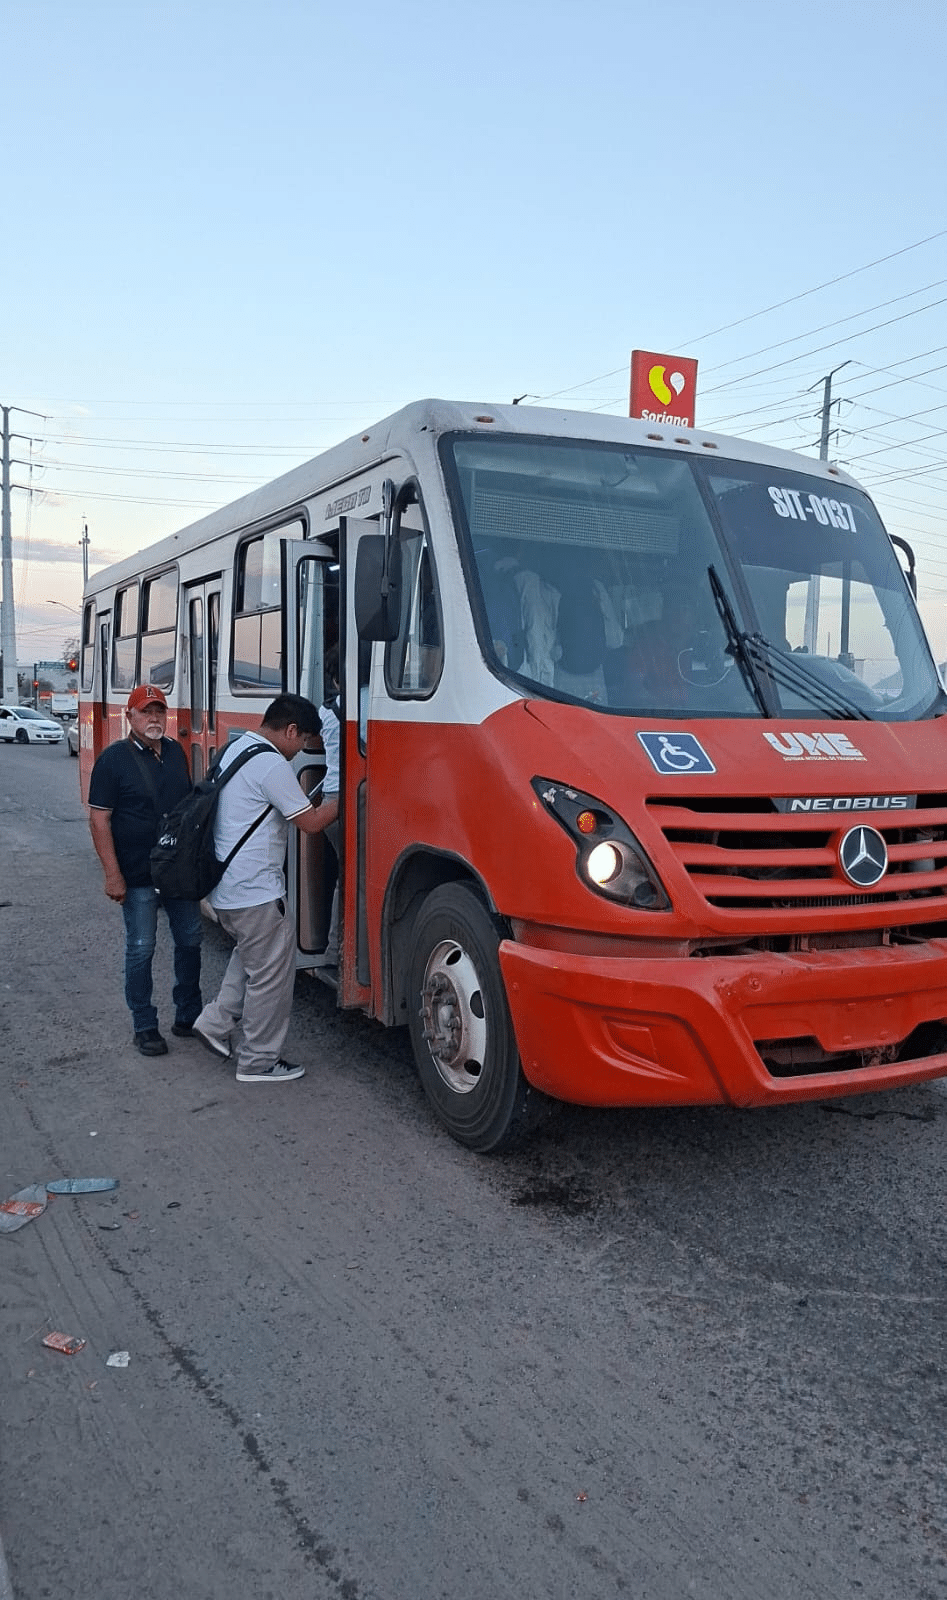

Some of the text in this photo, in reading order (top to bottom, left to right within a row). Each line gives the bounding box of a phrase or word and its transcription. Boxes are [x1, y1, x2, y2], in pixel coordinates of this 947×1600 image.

[641, 409, 689, 427] Soriana
[767, 486, 857, 533] SIT-0137
[762, 732, 864, 757] UNE
[790, 796, 908, 811] NEOBUS
